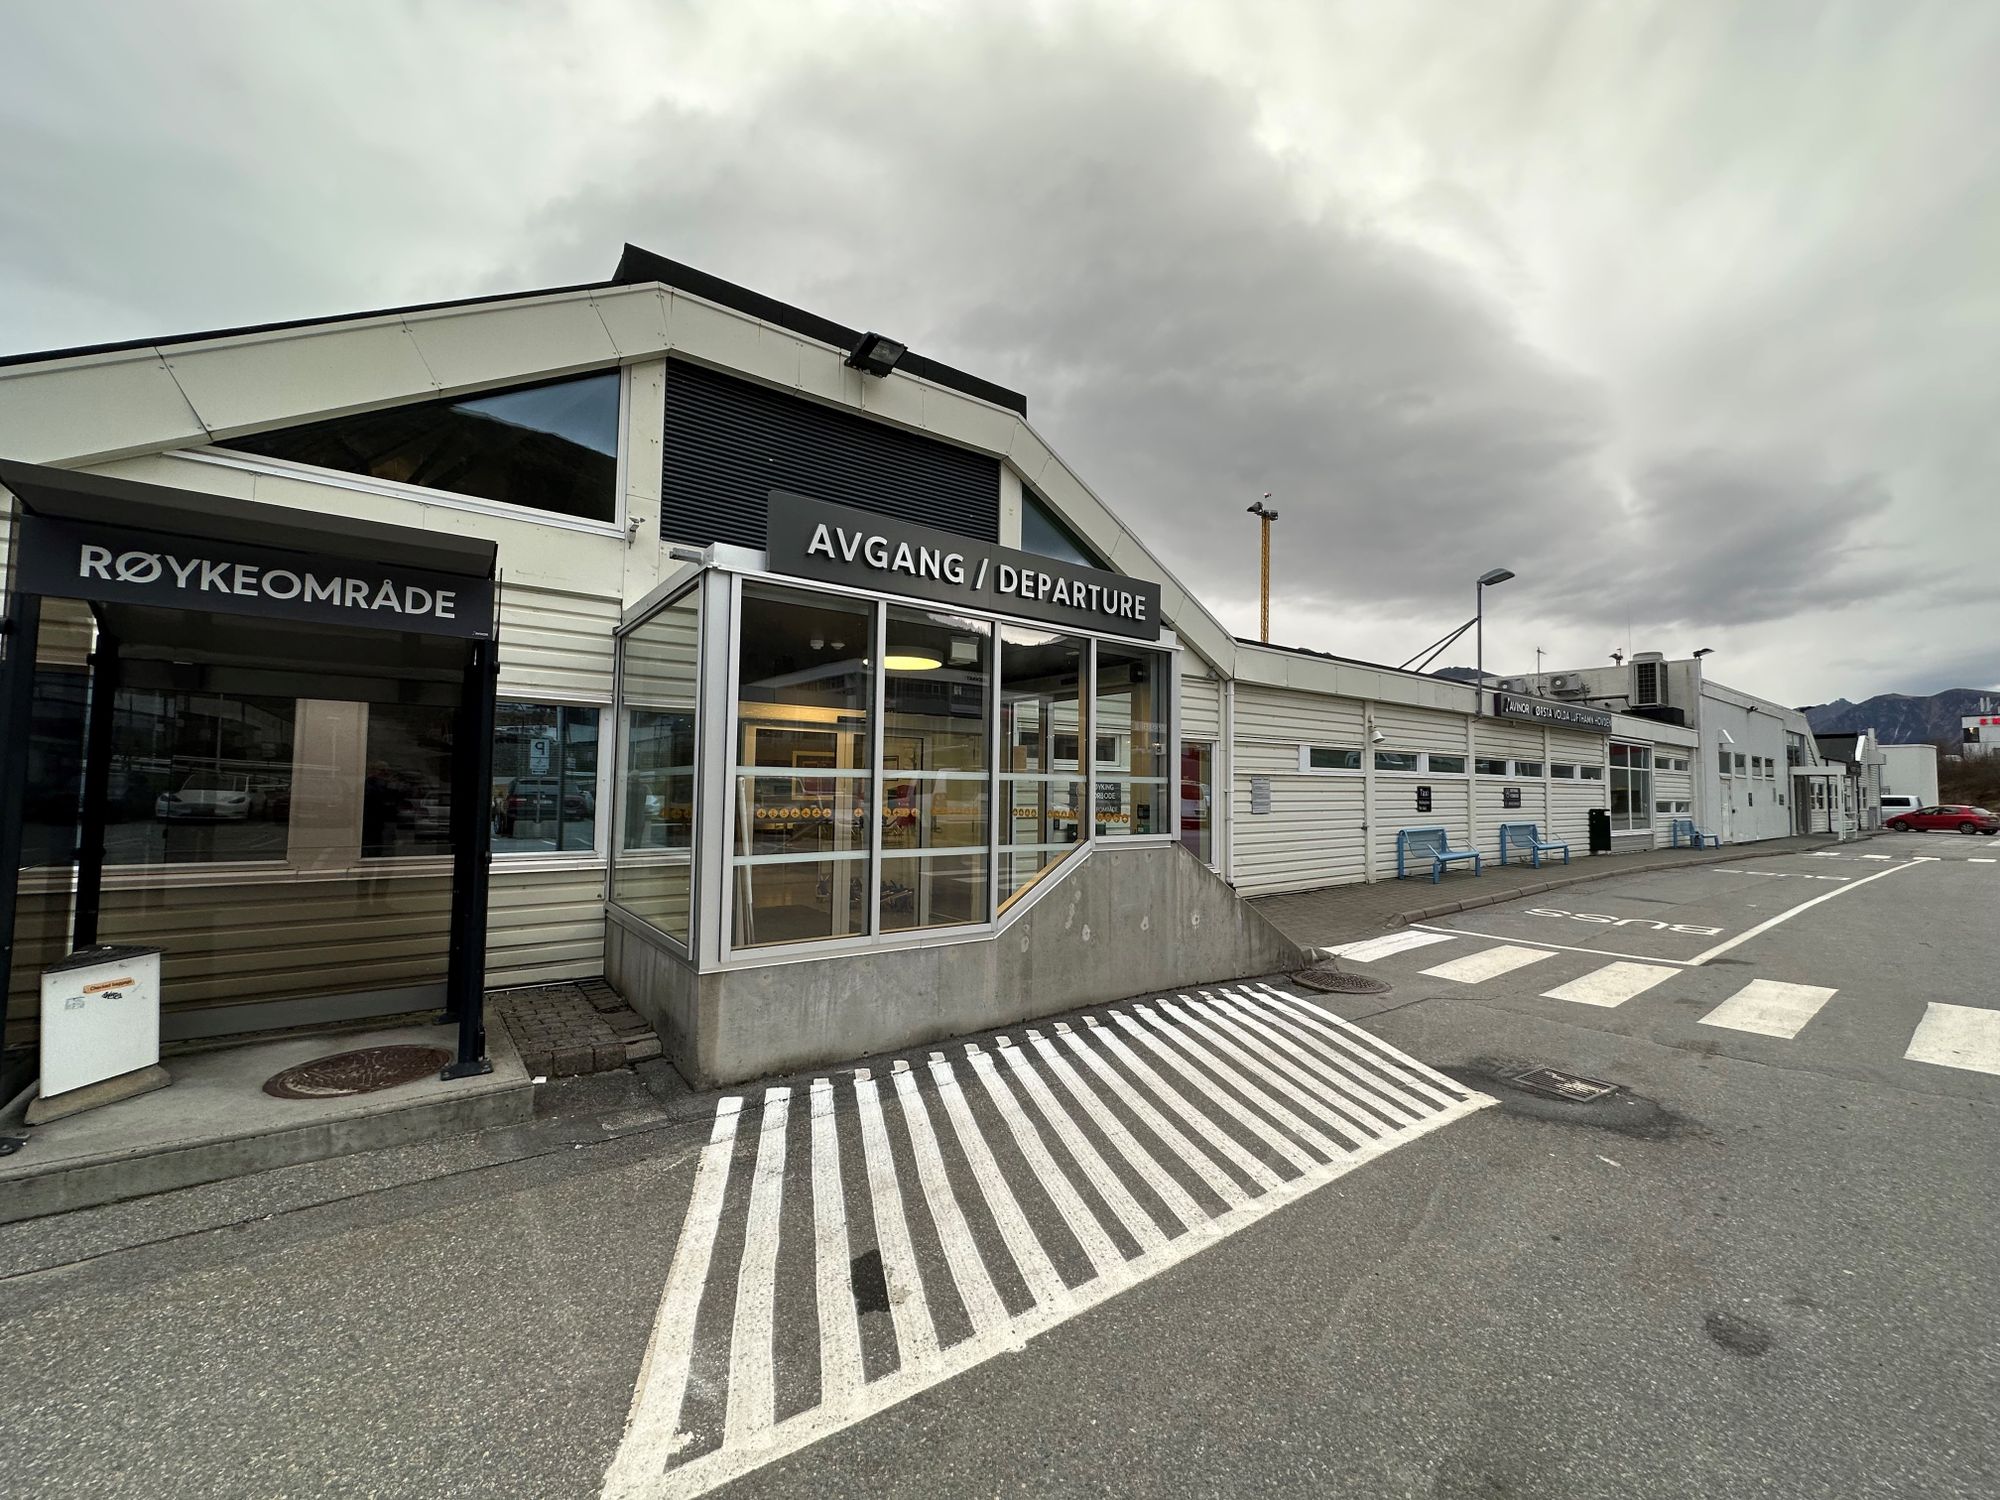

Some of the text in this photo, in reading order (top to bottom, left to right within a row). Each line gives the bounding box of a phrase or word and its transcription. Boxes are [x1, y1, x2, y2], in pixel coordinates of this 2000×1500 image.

[79, 543, 458, 620] RØYKEOMRÅDE
[807, 522, 1147, 621] AVGANG / DEPARTURE
[1509, 701, 1530, 714] AVINOR
[1524, 908, 1725, 936] BUSS
